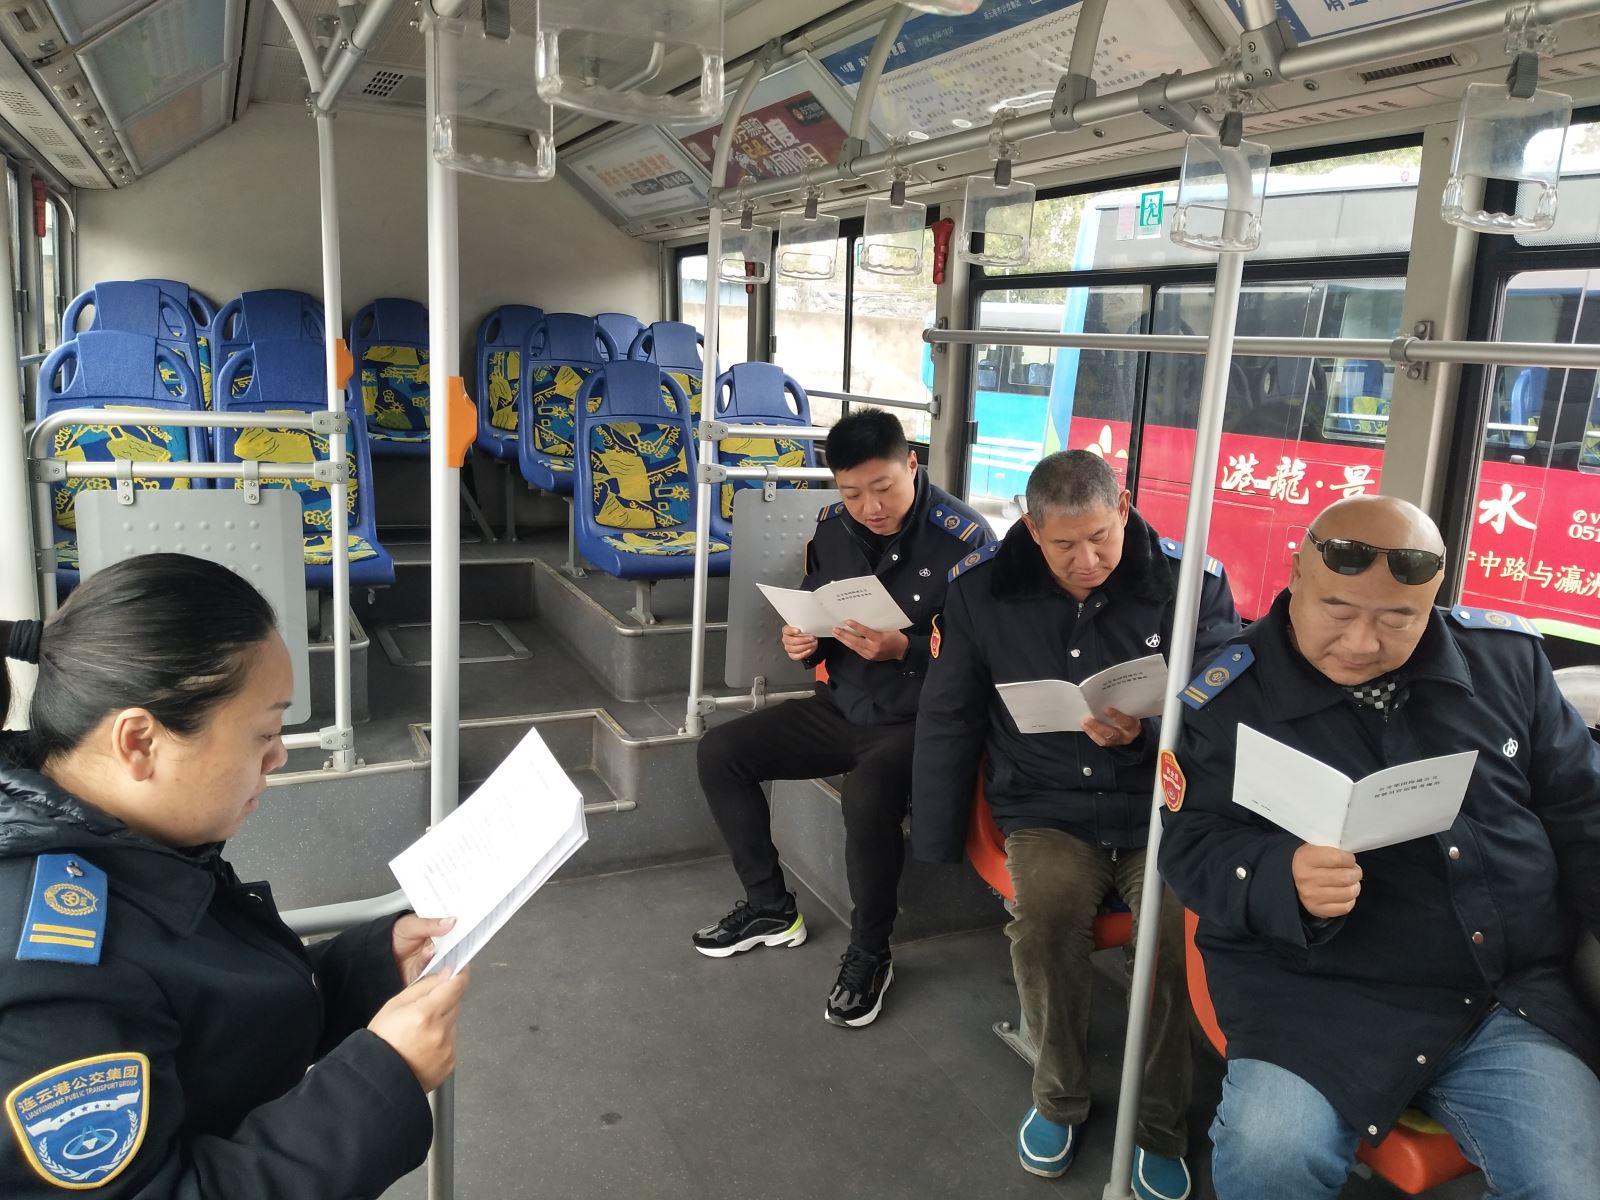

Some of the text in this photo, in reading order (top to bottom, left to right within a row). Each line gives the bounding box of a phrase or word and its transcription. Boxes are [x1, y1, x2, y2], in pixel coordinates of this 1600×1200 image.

[1478, 483, 1538, 535] 水
[18, 1065, 139, 1113] 连云港公交集团
